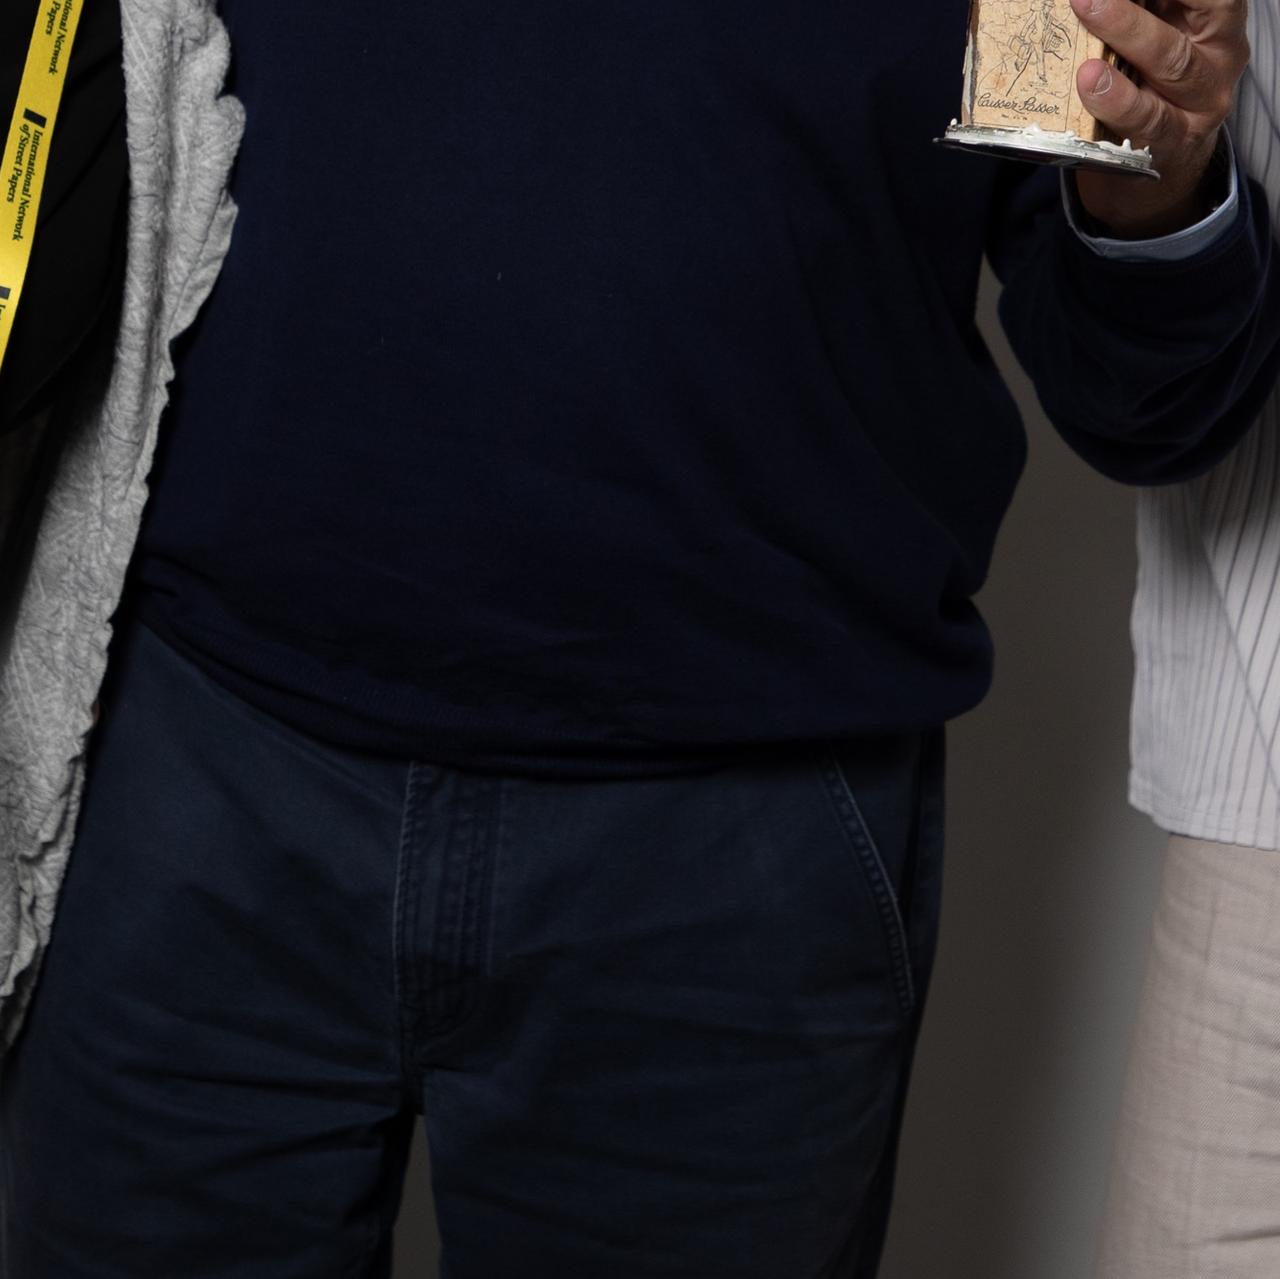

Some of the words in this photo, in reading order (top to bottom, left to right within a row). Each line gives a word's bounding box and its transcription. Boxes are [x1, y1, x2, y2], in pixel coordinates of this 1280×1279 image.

[45, 0, 61, 36] Papers
[48, 31, 66, 76] Network
[19, 123, 31, 138] of
[15, 135, 29, 166] Street
[22, 129, 43, 198] International
[6, 167, 23, 203] Papers
[12, 196, 30, 242] Network
